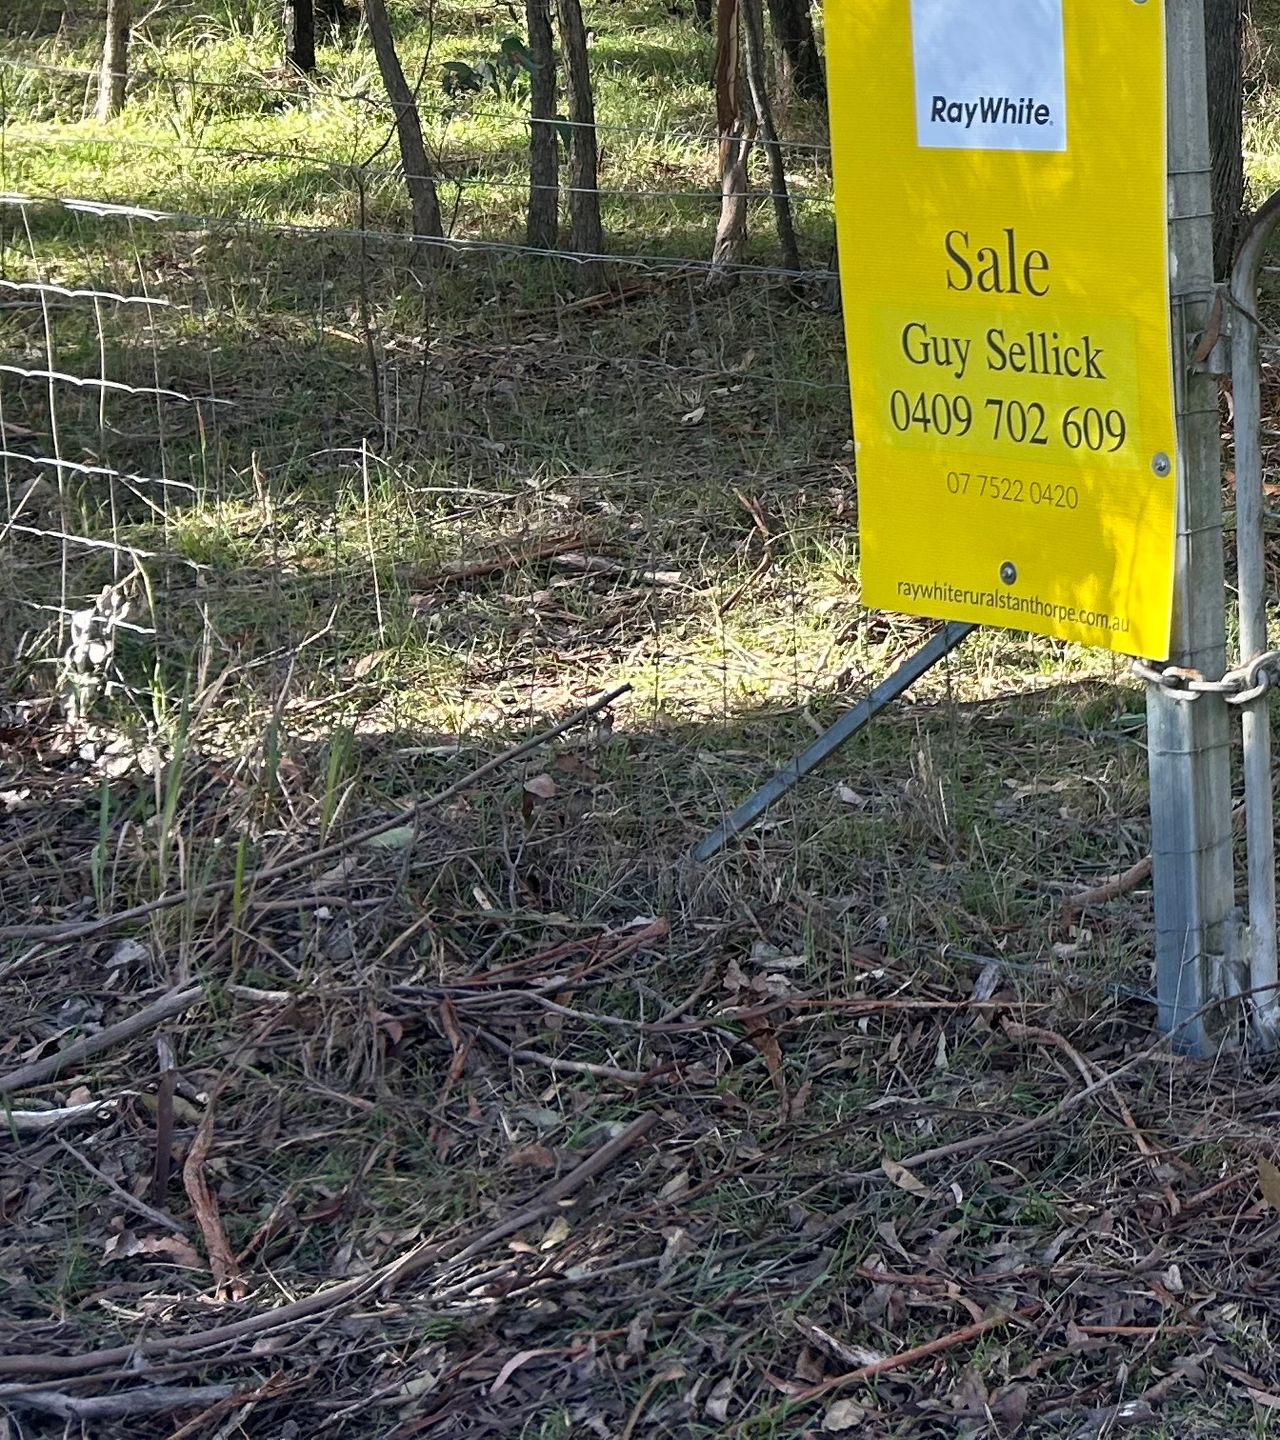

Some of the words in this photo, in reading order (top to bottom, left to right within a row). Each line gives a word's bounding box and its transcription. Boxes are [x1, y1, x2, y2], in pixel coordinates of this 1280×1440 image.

[944, 228, 1050, 296] Sale
[902, 322, 971, 379] Guy
[986, 328, 1107, 379] Sellick
[890, 389, 973, 437] 0409
[984, 398, 1048, 445] 702
[1062, 406, 1127, 452] 609
[946, 471, 970, 494] 07
[977, 475, 1024, 502] 7522
[1029, 481, 1078, 509] 0420
[897, 580, 1130, 632] raywhiteruralstanthorpe.com.au
